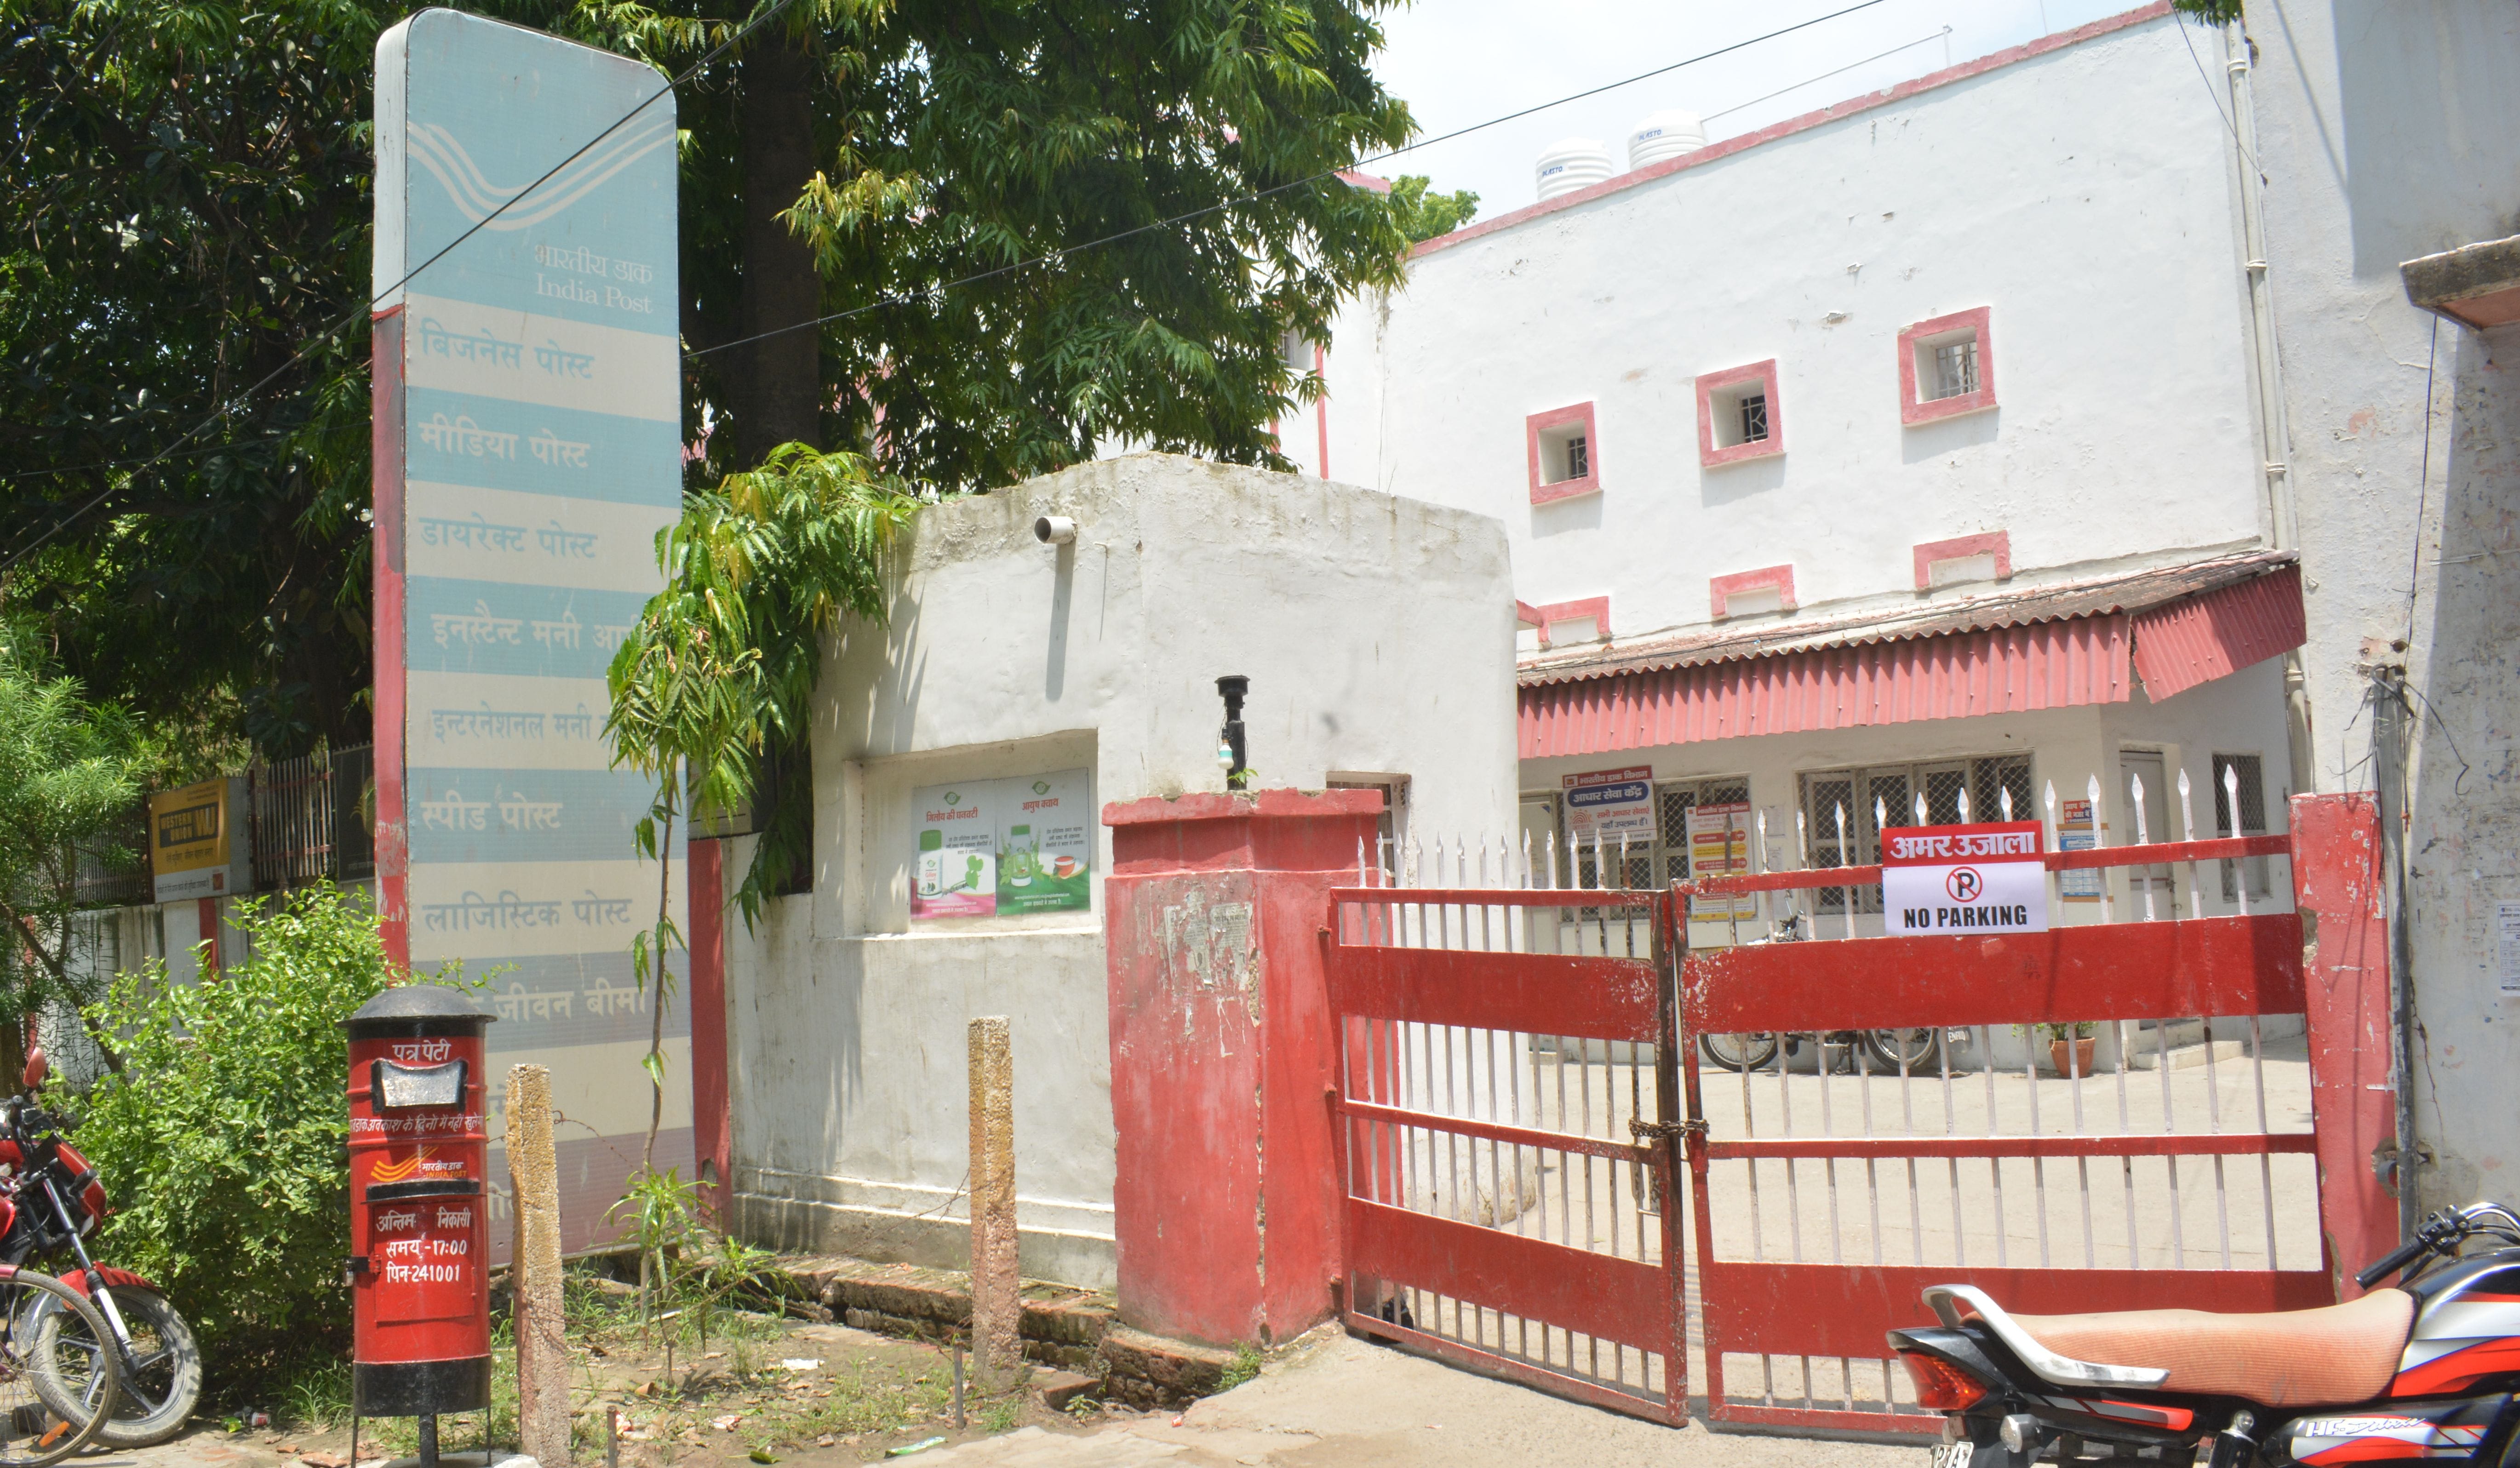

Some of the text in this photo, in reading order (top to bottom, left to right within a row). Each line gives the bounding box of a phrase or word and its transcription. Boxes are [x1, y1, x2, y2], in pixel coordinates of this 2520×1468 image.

[1638, 129, 1662, 142] PLASTO
[1542, 166, 1563, 177] PLASTO
[534, 244, 653, 284] भारतीय डाक
[535, 273, 653, 314] India Post
[419, 317, 595, 380] बिजनेस पोस्ट
[418, 412, 590, 468] मीडिया पोस्ट
[418, 511, 598, 559] डायरेक्ट पोस्ट
[531, 611, 582, 653] मनी
[554, 702, 592, 741] मनी
[1580, 770, 1648, 784] भारतीय डाक विभाग
[1573, 785, 1643, 803] आधार सेवा केंद्र
[160, 811, 193, 830] WESTERN
[420, 790, 563, 830] स्पीड पोस्ट
[926, 810, 945, 823] गिलोय
[946, 808, 955, 821] की
[1597, 809, 1610, 818] सभी
[1612, 809, 1631, 817] आधार
[1615, 820, 1637, 828] उपलब्ध
[1890, 831, 2036, 859] अमर उजाला
[422, 890, 632, 932] लाजिस्टिक पोस्ट
[1904, 904, 2027, 928] NO PARKING
[493, 977, 648, 1023] जीवन बीमा
[392, 1038, 451, 1062] पत्र पेटी
[422, 1160, 464, 1171] भारतीय डाक
[437, 1206, 471, 1229] निकासी
[386, 1240, 422, 1258] समय
